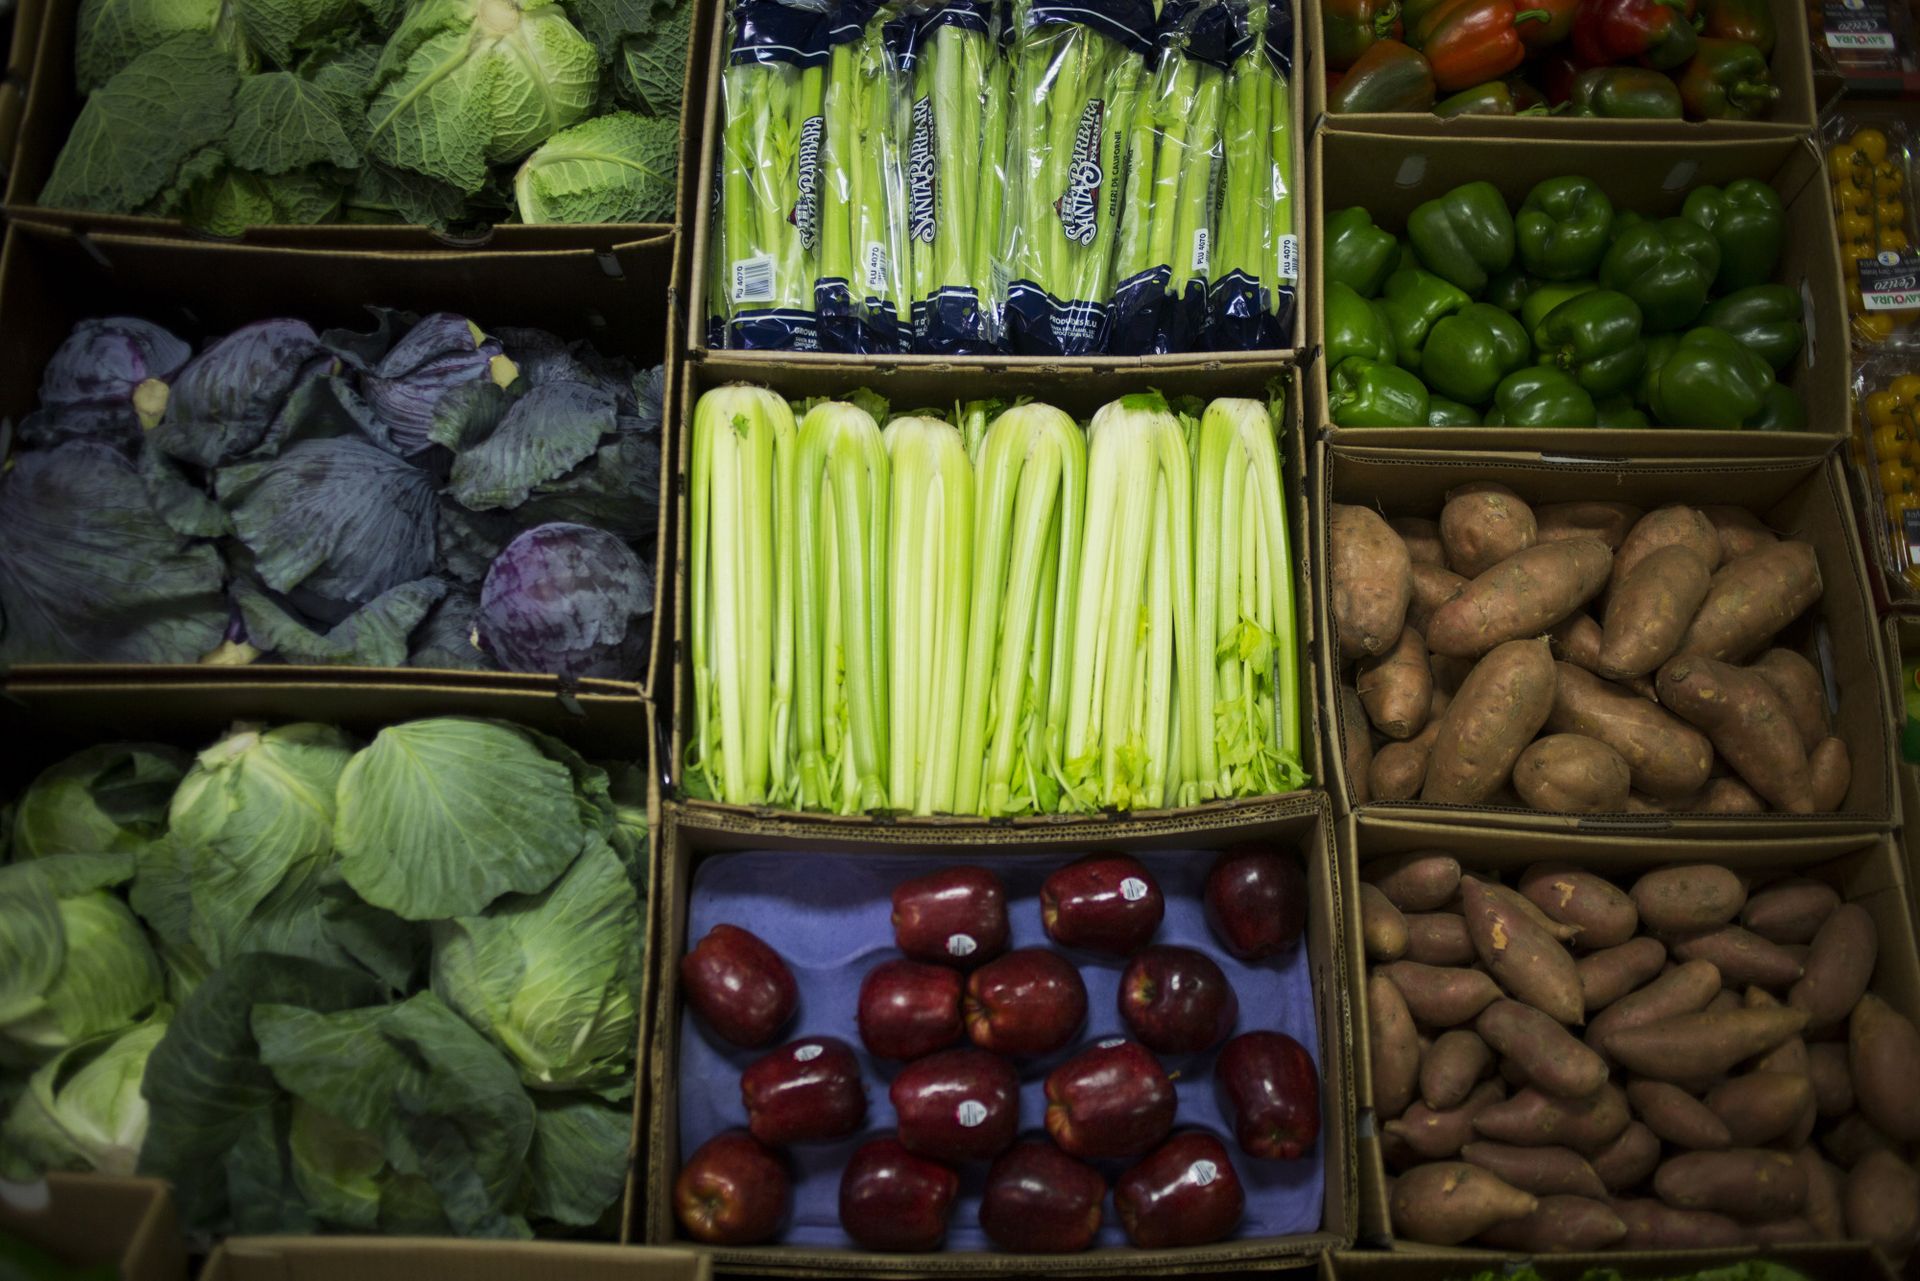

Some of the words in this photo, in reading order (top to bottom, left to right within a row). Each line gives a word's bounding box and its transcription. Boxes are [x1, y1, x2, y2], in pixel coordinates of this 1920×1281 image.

[1834, 34, 1886, 45] SAVOURA
[909, 96, 936, 183] BARBARA
[1068, 99, 1103, 188] BARBARA
[799, 116, 824, 192] BARBARA
[1112, 130, 1122, 174] CALIFORNIE
[911, 180, 936, 243] SANTA
[1064, 183, 1097, 245] SANTA
[871, 247, 879, 267] 4070
[1196, 252, 1205, 265] PLU
[1283, 239, 1291, 259] 4070
[736, 265, 744, 286] 4070
[1283, 261, 1291, 275] PLU
[1874, 274, 1916, 292] Cerizo
